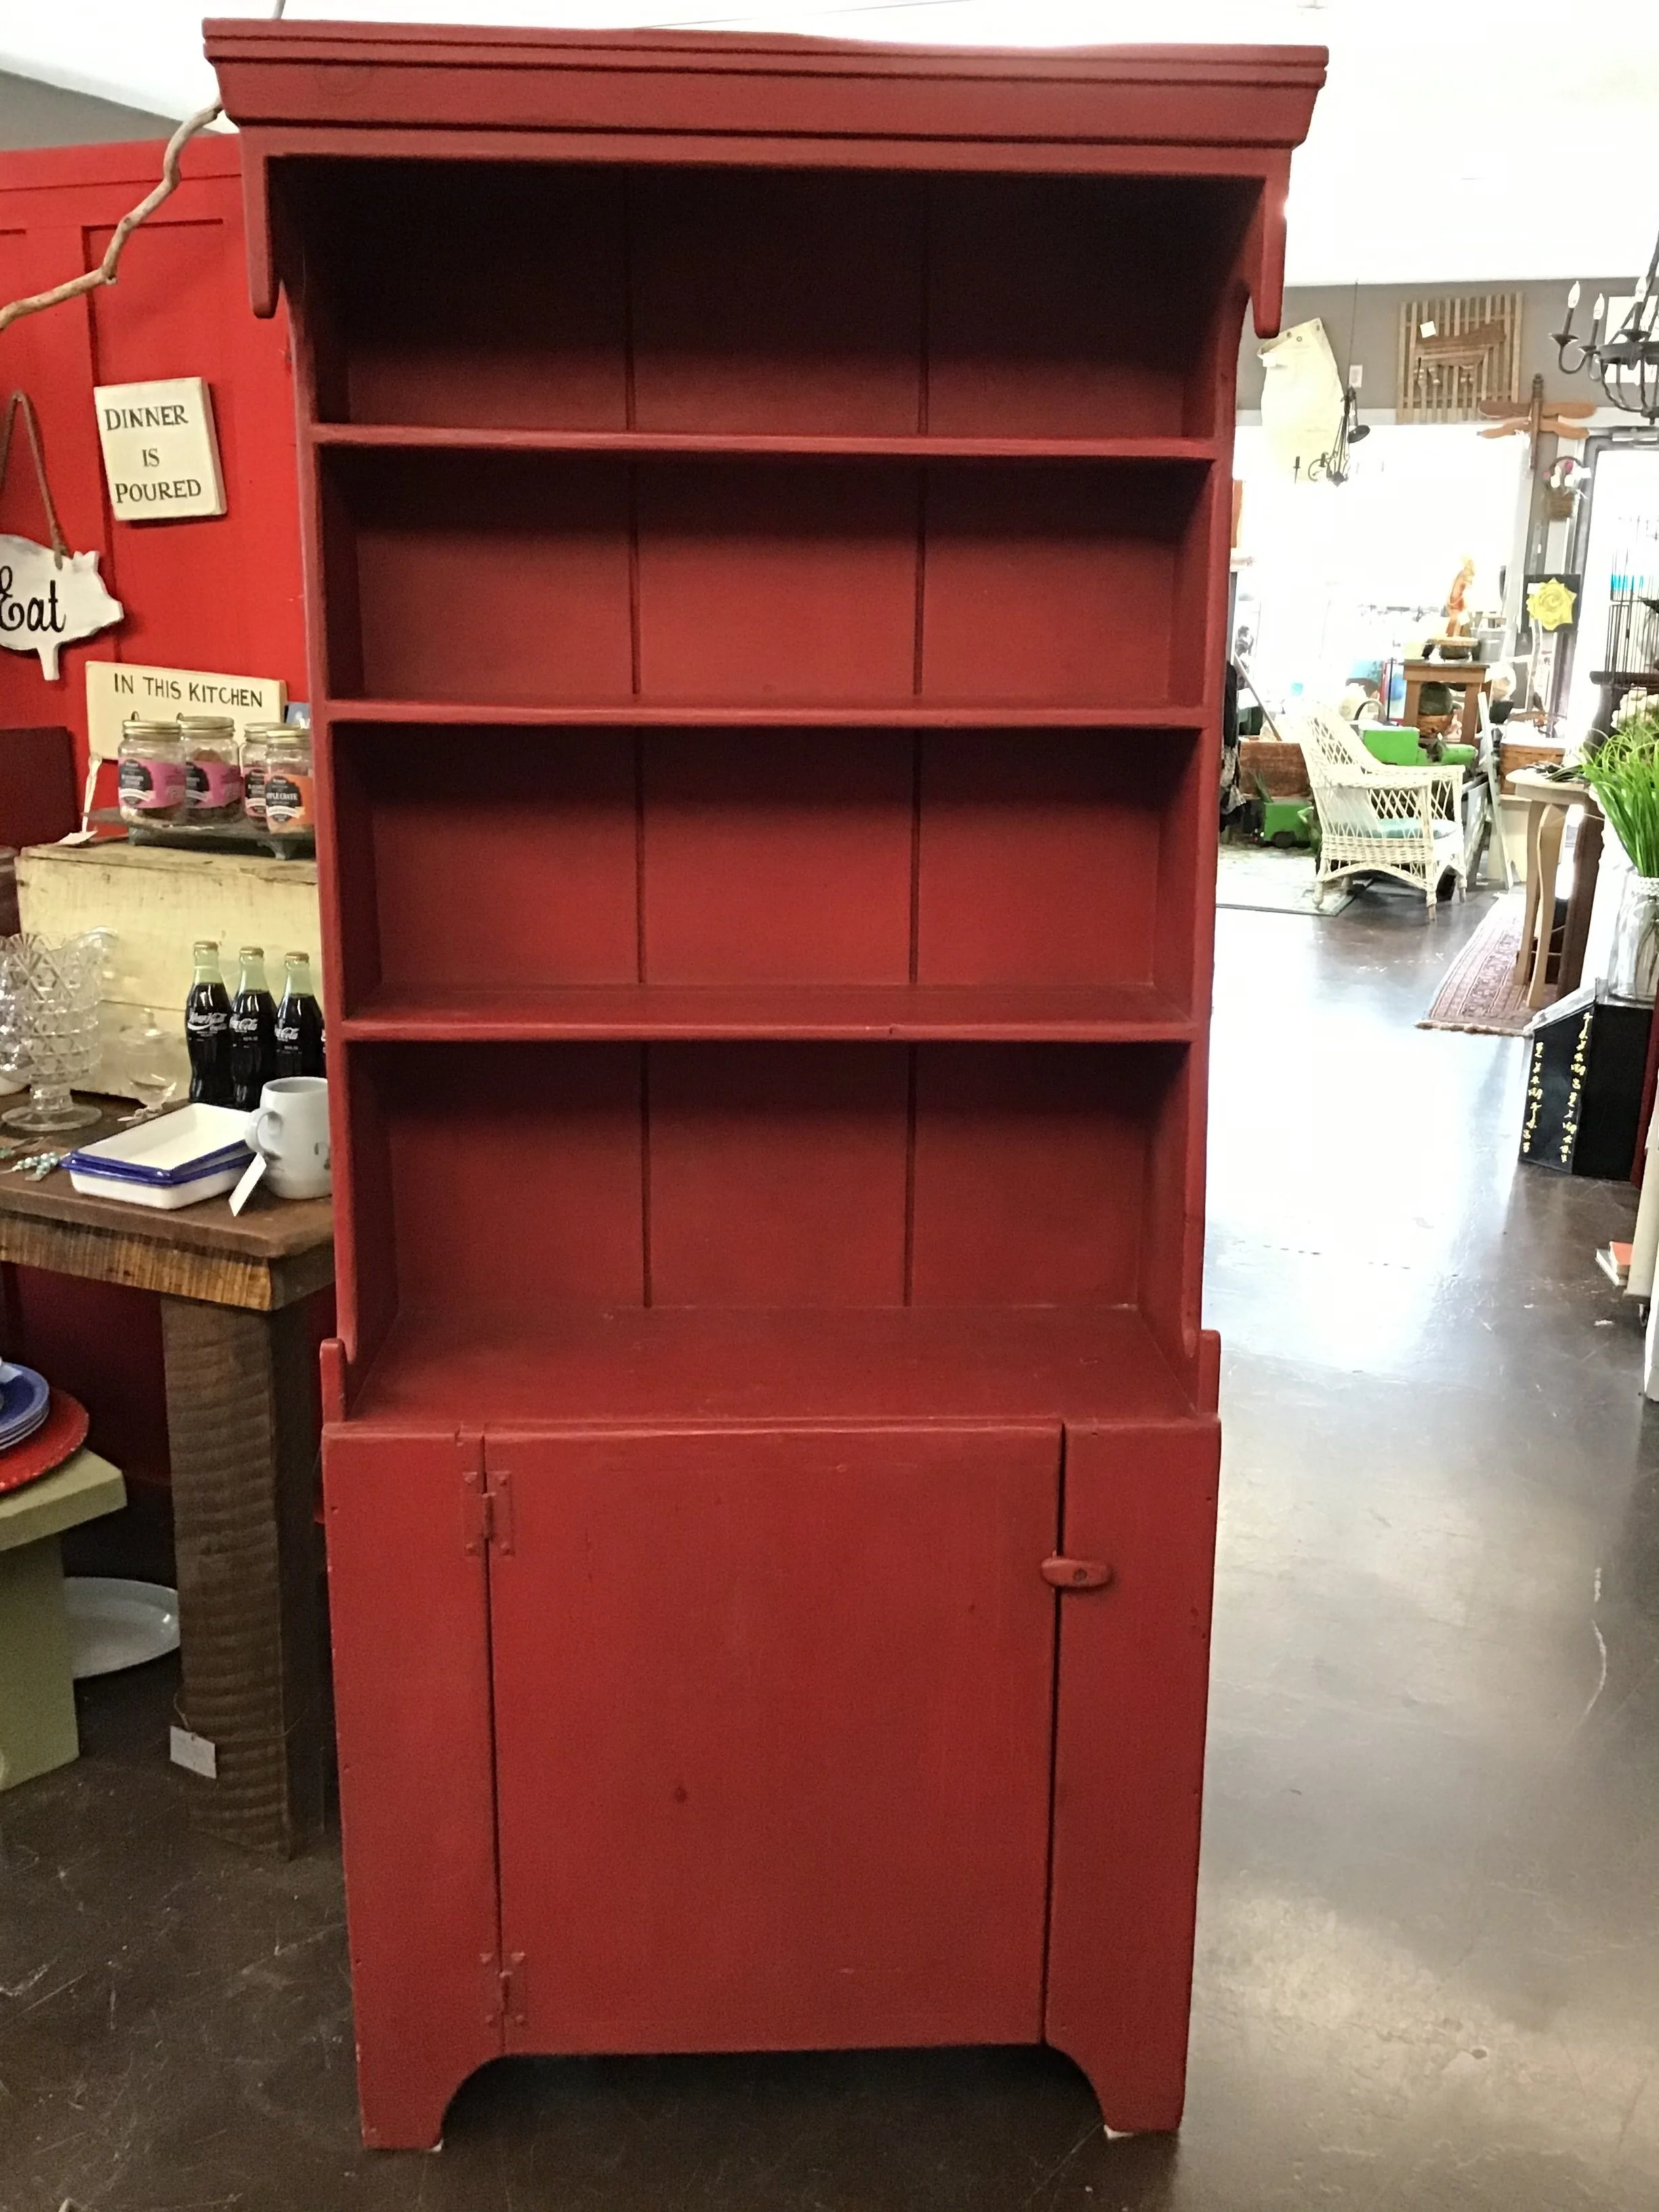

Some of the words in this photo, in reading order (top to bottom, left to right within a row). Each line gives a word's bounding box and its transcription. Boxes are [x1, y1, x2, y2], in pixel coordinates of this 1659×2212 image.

[104, 405, 189, 431] DINNER
[142, 448, 161, 468] IS
[115, 479, 202, 504] POURED
[0, 565, 66, 633] Eat
[114, 673, 134, 695] IN
[142, 676, 182, 700] THIS
[189, 682, 263, 708] KITCHEN
